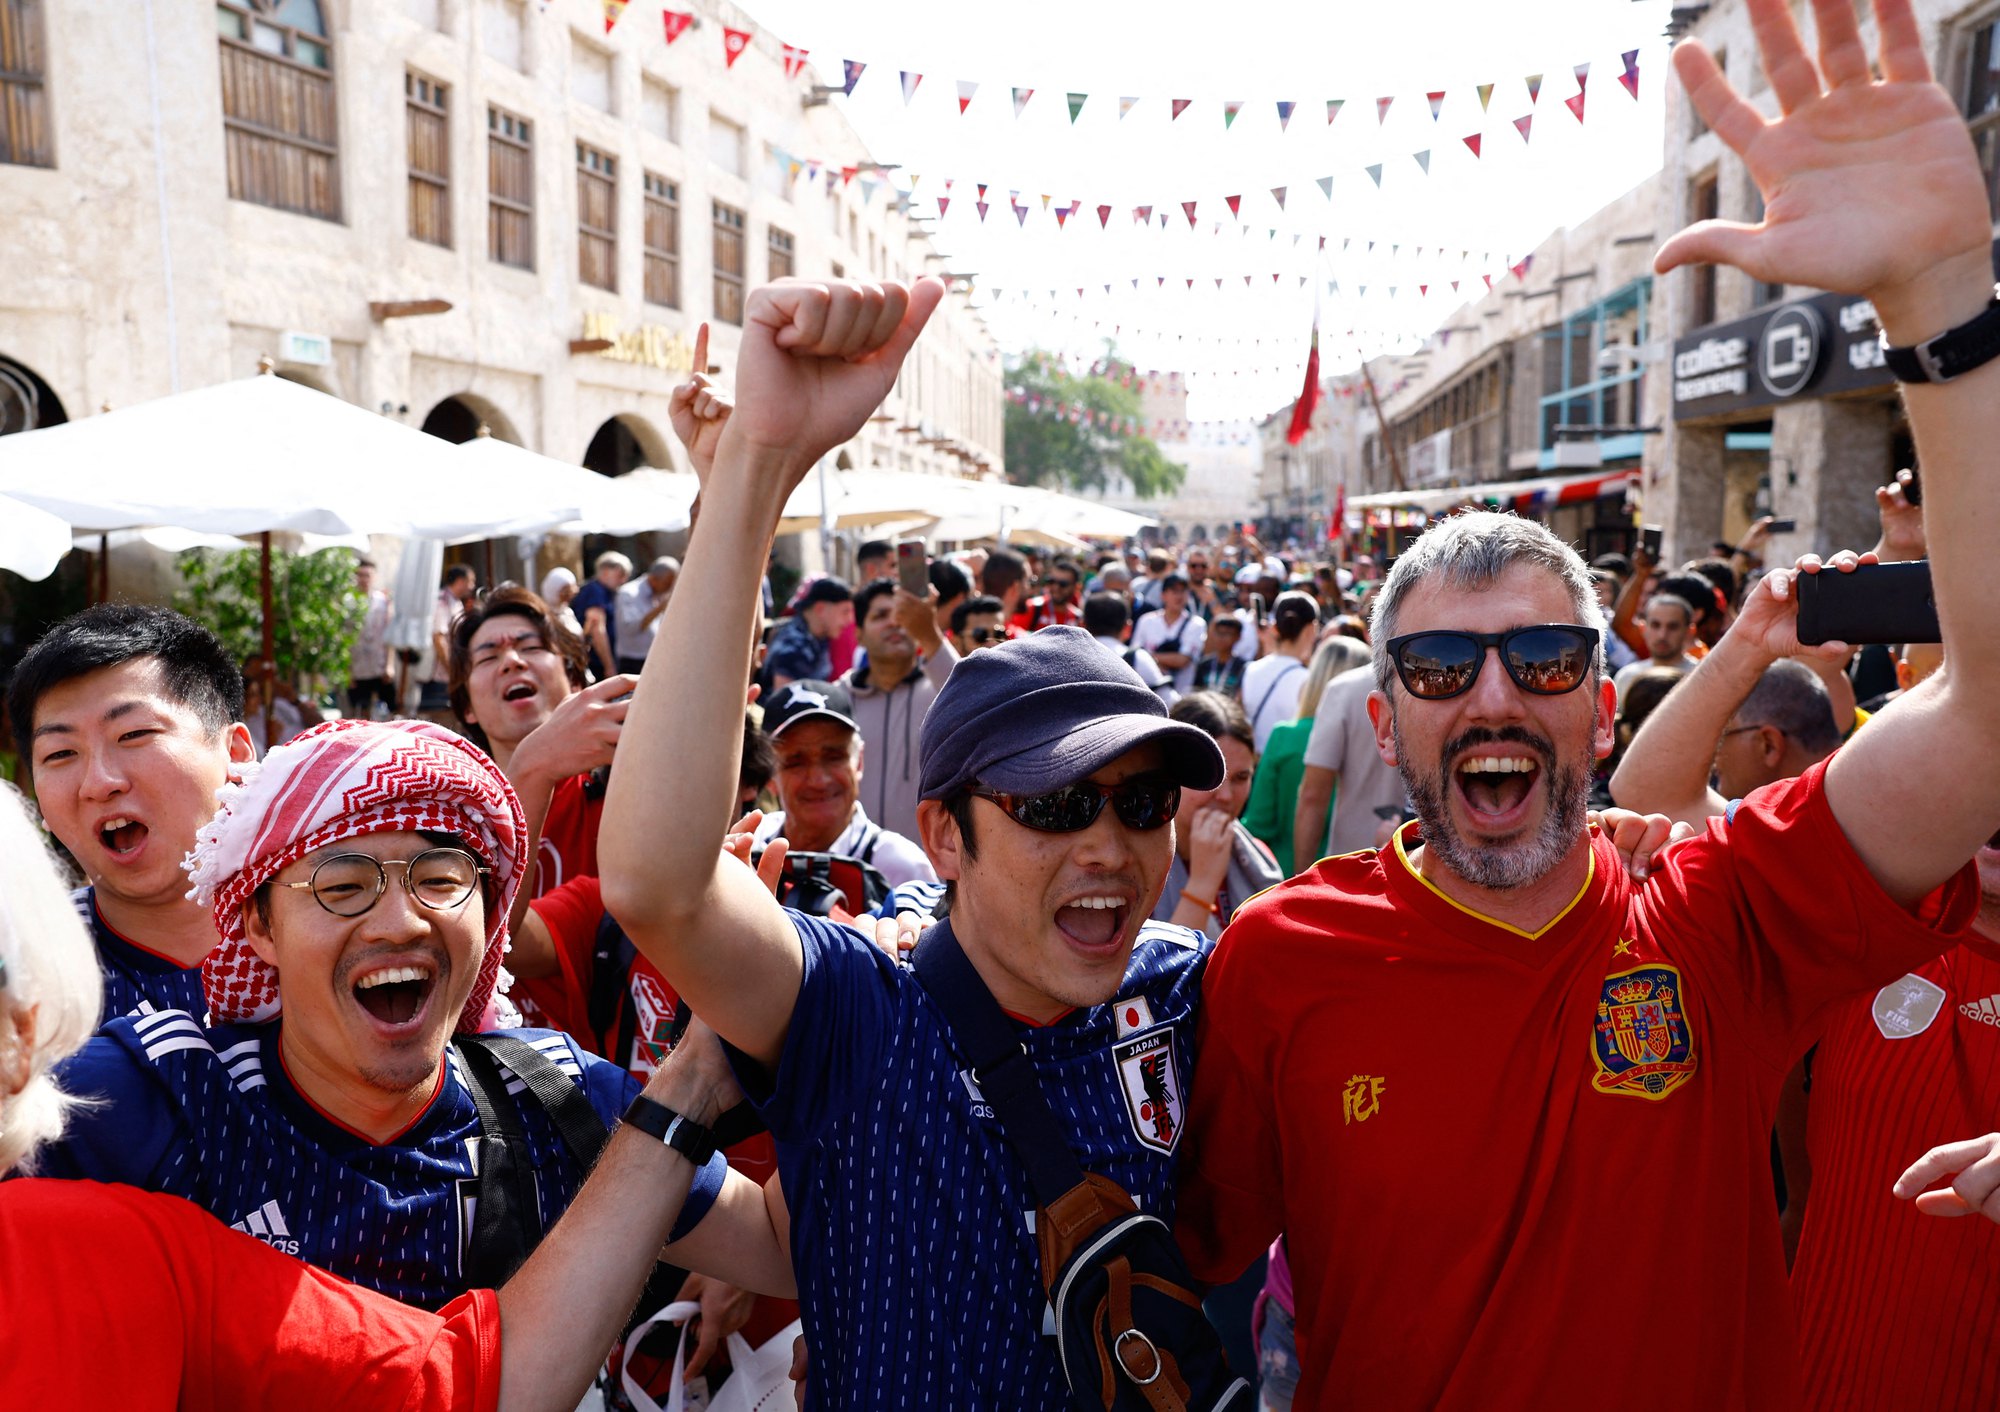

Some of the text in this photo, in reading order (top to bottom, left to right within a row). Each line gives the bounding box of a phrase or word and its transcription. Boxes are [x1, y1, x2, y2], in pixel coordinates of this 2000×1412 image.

[1675, 338, 1747, 379] coffee
[1885, 1010, 1910, 1028] FIFA
[1129, 1036, 1160, 1057] JAPAN
[1152, 1113, 1176, 1139] JFA
